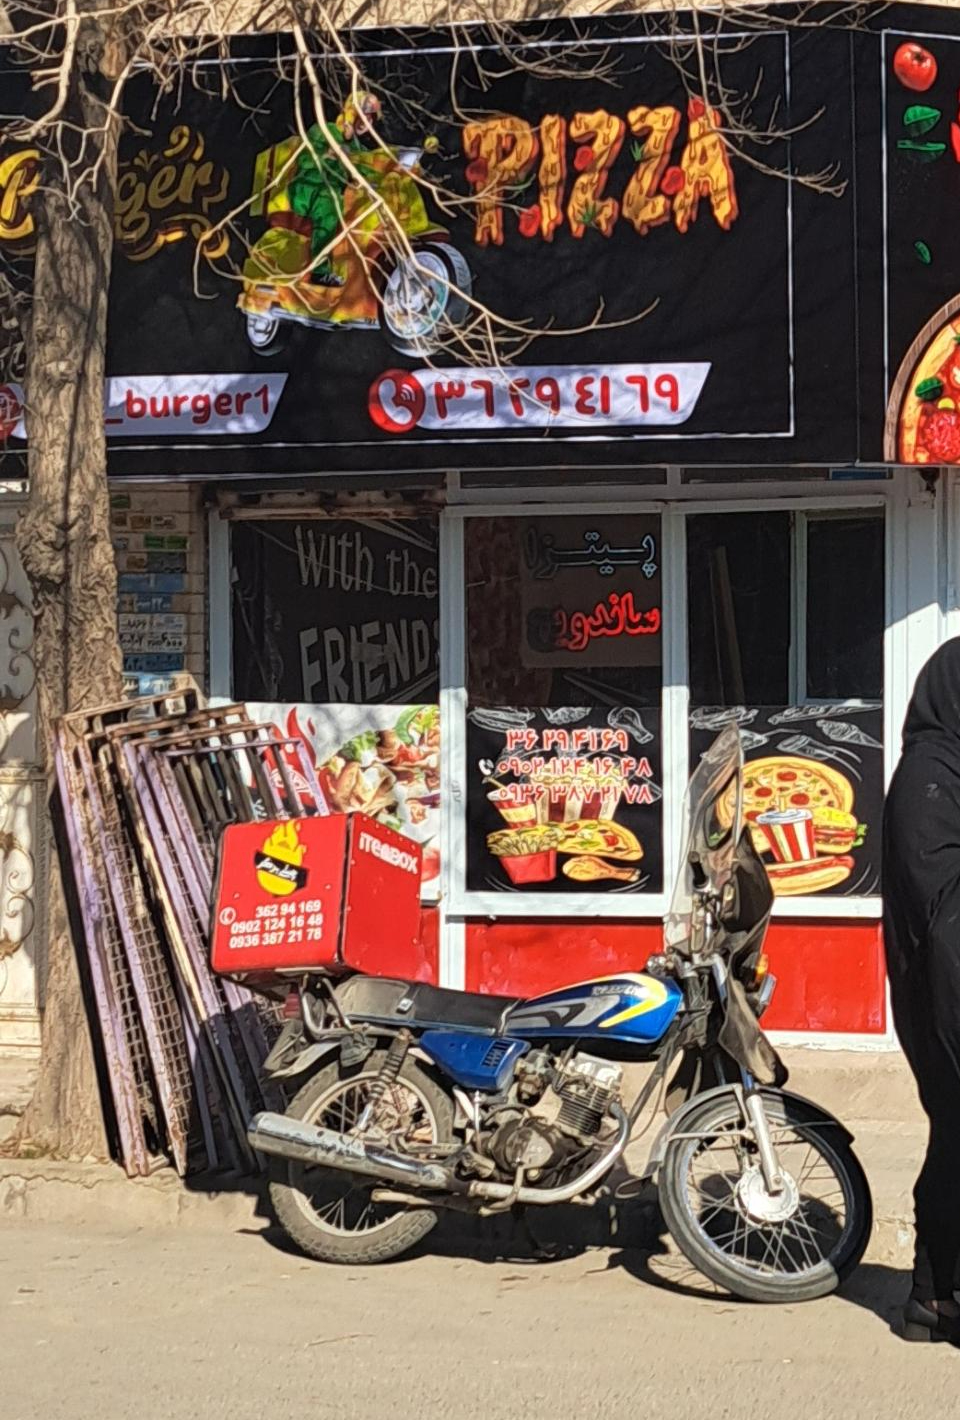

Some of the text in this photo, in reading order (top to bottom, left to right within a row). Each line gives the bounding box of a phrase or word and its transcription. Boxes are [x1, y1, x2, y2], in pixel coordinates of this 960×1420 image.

[462, 95, 739, 249] PIZZA
[386, 549, 437, 598] the
[300, 620, 440, 703] FRIEND
[231, 913, 323, 934] 0902 124 16 48
[256, 900, 321, 918] 362 94 169
[230, 927, 322, 948] 0936 387 21 78
